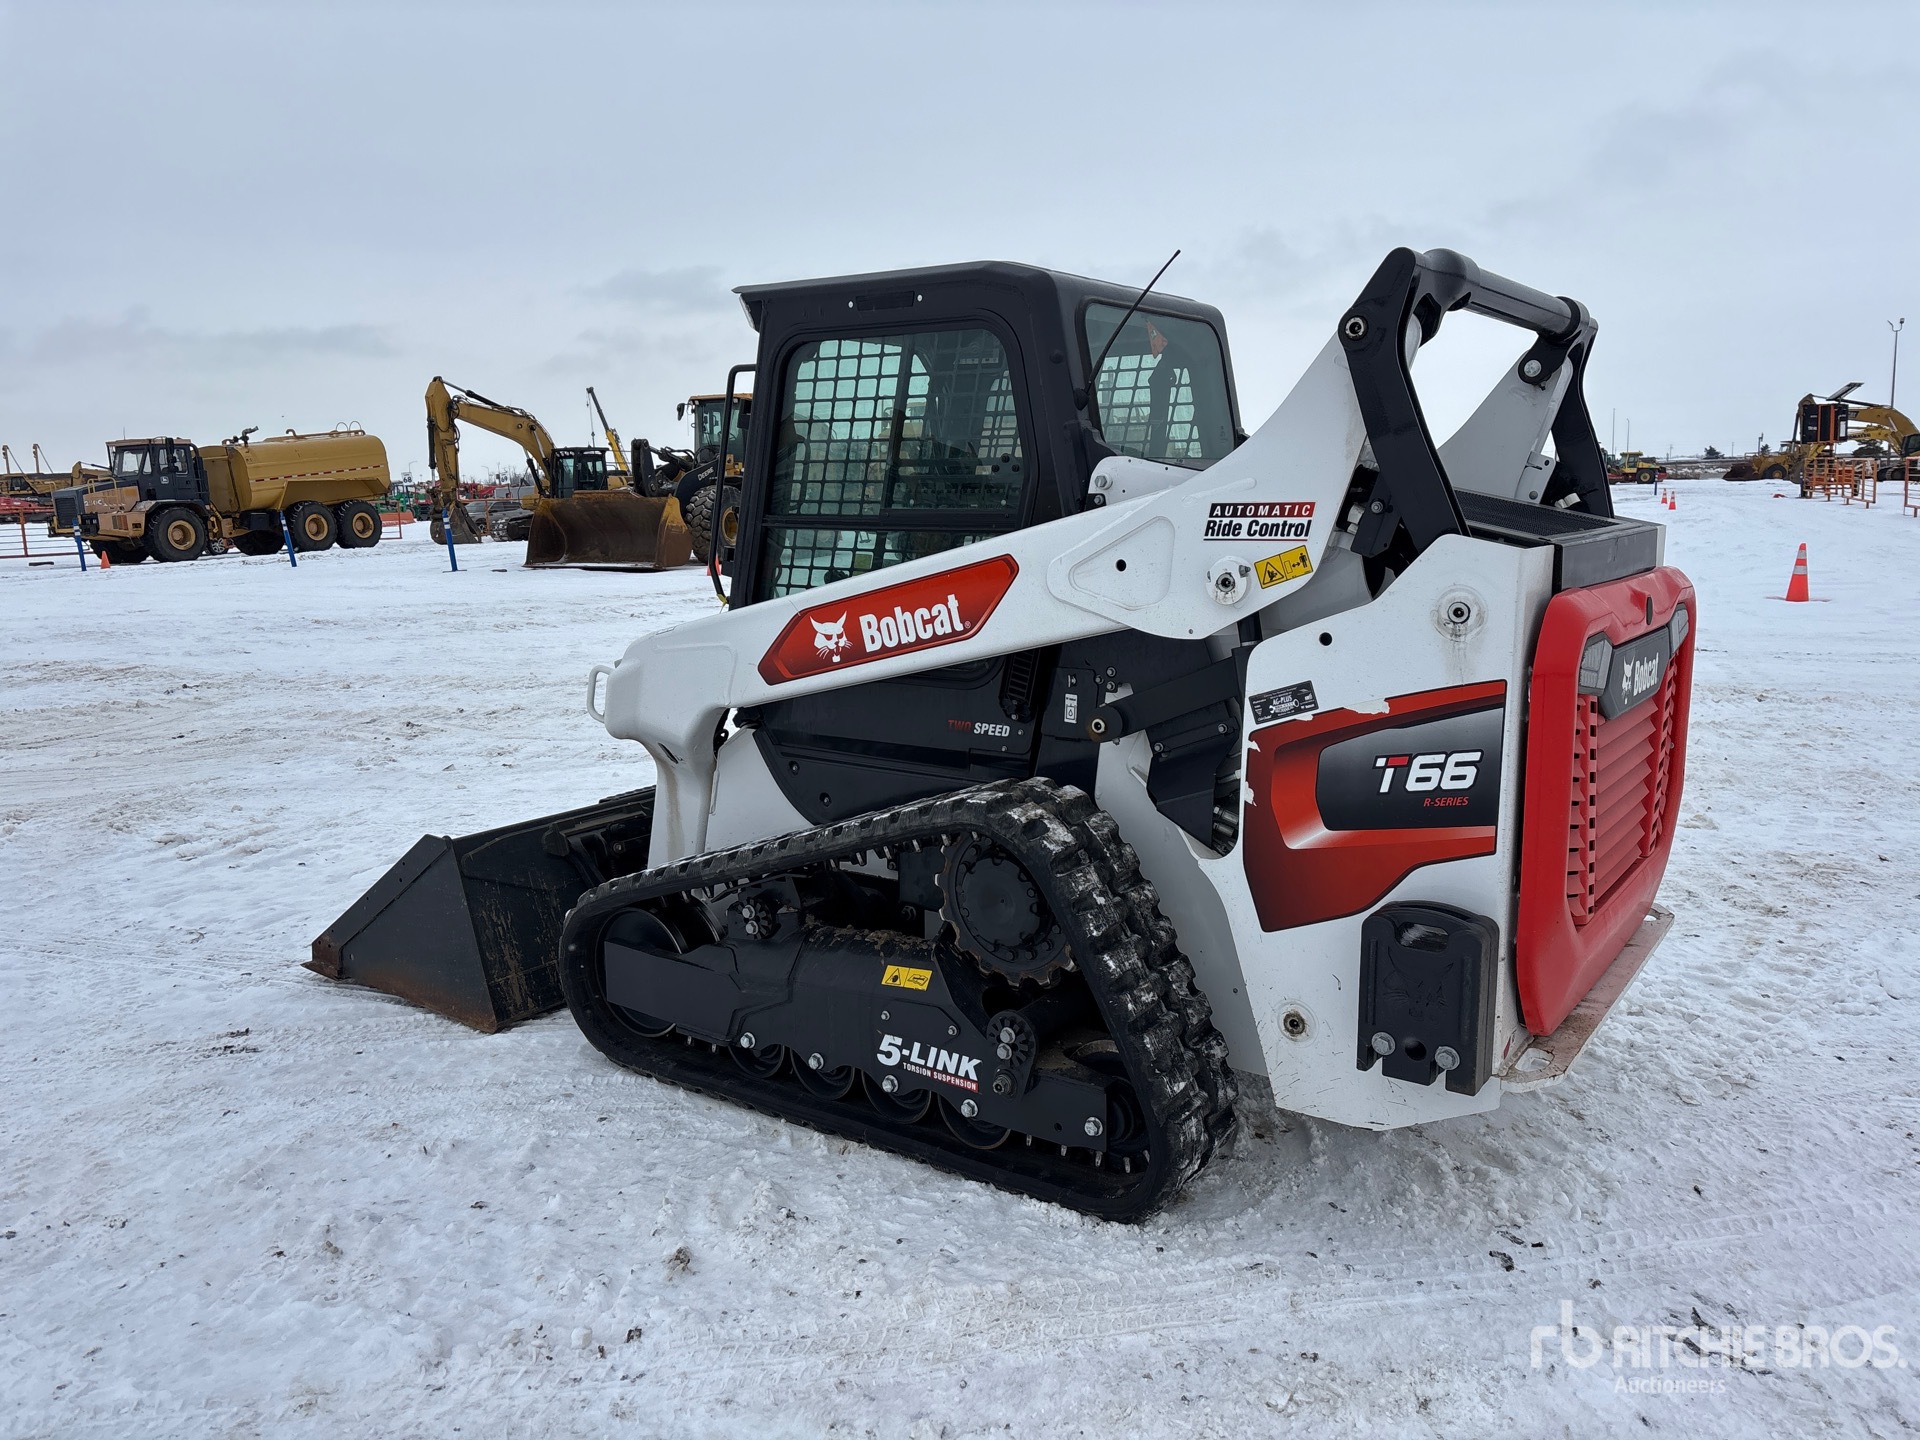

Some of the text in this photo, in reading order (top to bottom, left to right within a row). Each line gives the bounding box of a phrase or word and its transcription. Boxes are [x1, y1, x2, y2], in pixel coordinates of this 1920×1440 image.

[403, 476, 412, 484] 68
[698, 467, 714, 481] DEERE
[1213, 504, 1312, 517] AUTOMATIC
[1204, 519, 1312, 538] Ride Control
[858, 593, 963, 653] Bobcat
[1633, 652, 1659, 696] Bobcat
[947, 719, 1011, 737] TWO SPEED
[1374, 750, 1483, 794] T66
[1423, 796, 1469, 807] R-SERIES
[877, 1034, 982, 1081] 5-LINK
[902, 1061, 977, 1091] TORSION SUSPENSION
